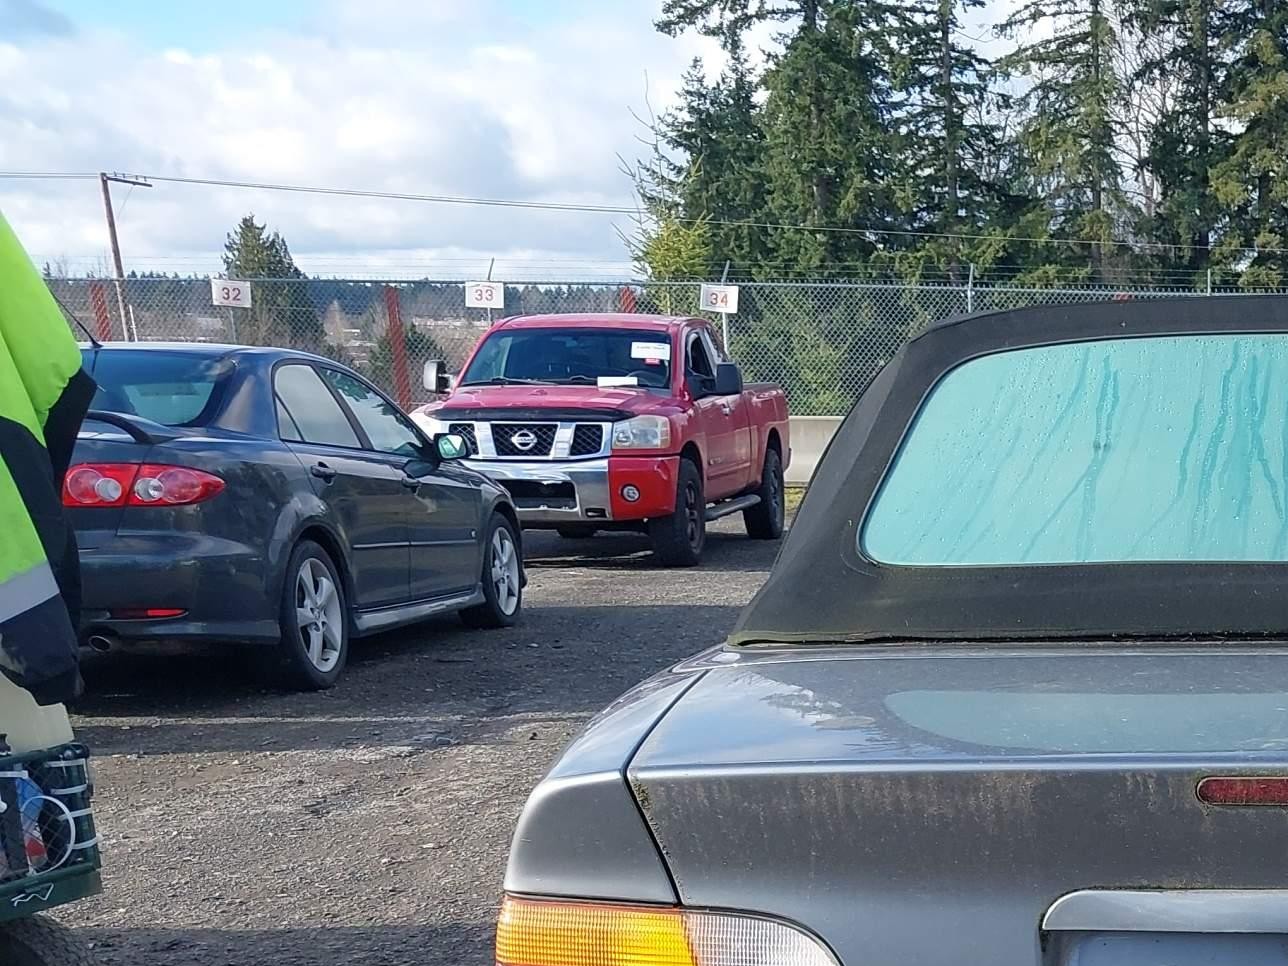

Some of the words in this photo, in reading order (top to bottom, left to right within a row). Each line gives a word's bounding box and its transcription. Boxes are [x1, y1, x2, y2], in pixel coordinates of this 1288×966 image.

[222, 286, 241, 301] 32
[474, 288, 494, 302] 33
[710, 292, 728, 307] 34
